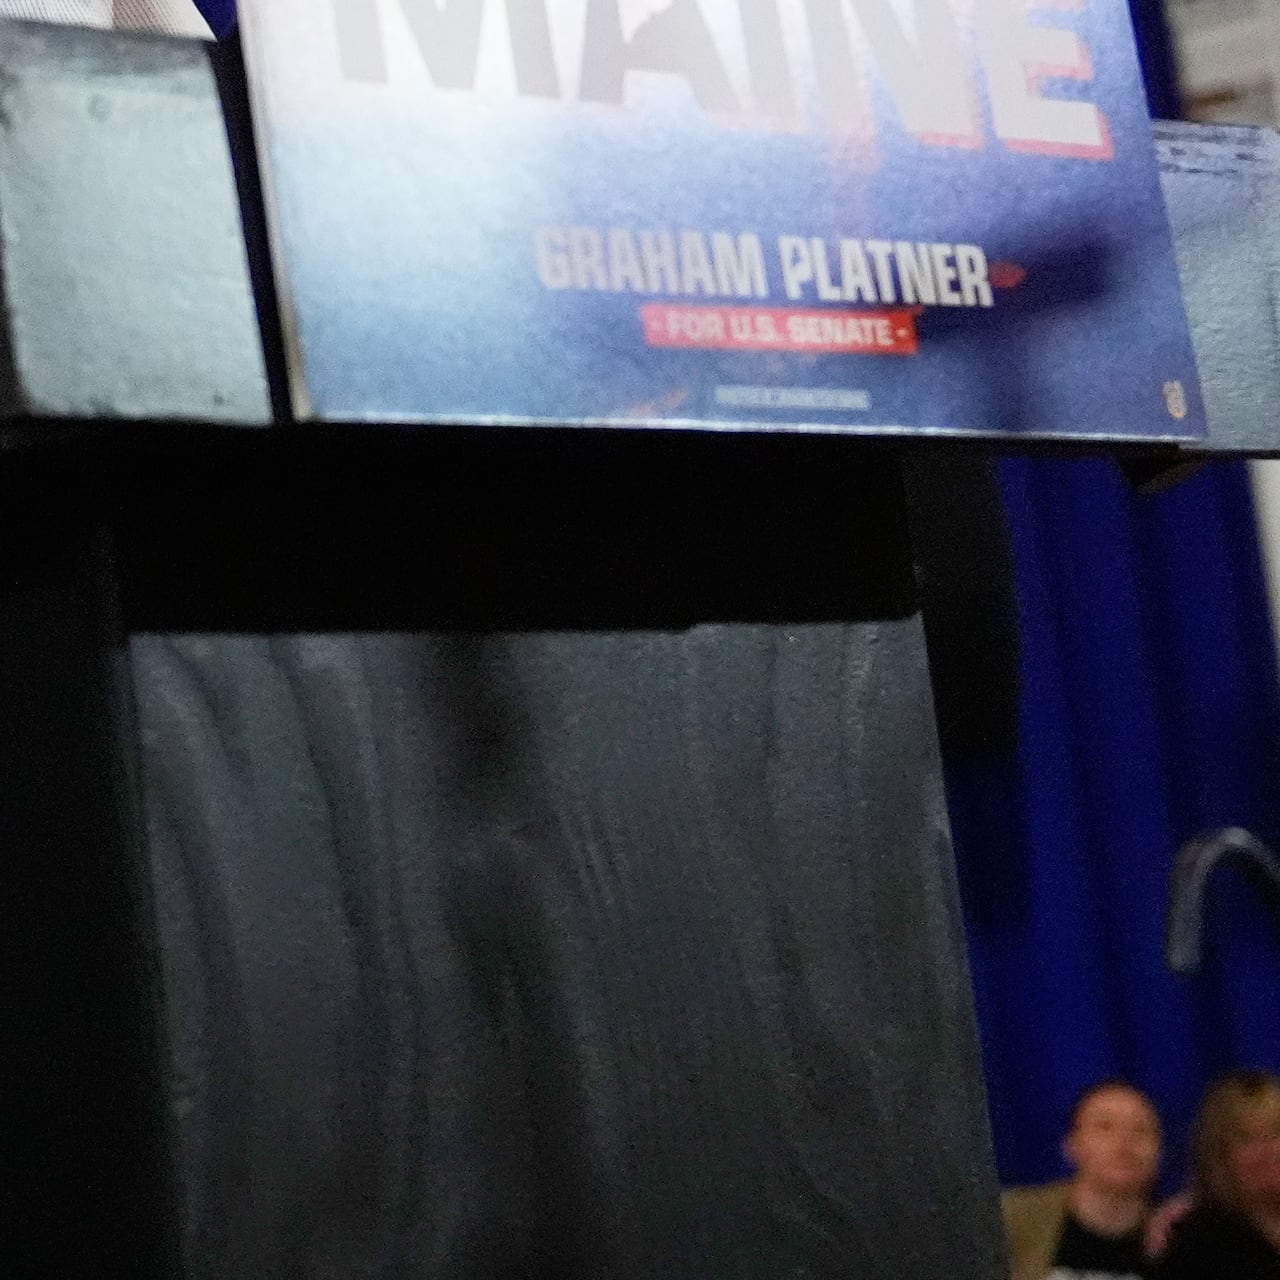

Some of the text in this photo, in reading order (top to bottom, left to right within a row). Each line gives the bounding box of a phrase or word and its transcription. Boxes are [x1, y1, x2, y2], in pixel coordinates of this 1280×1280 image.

[536, 223, 994, 308] GRAHAM PLATNER
[665, 311, 724, 341] FOR
[787, 315, 895, 347] SENATE
